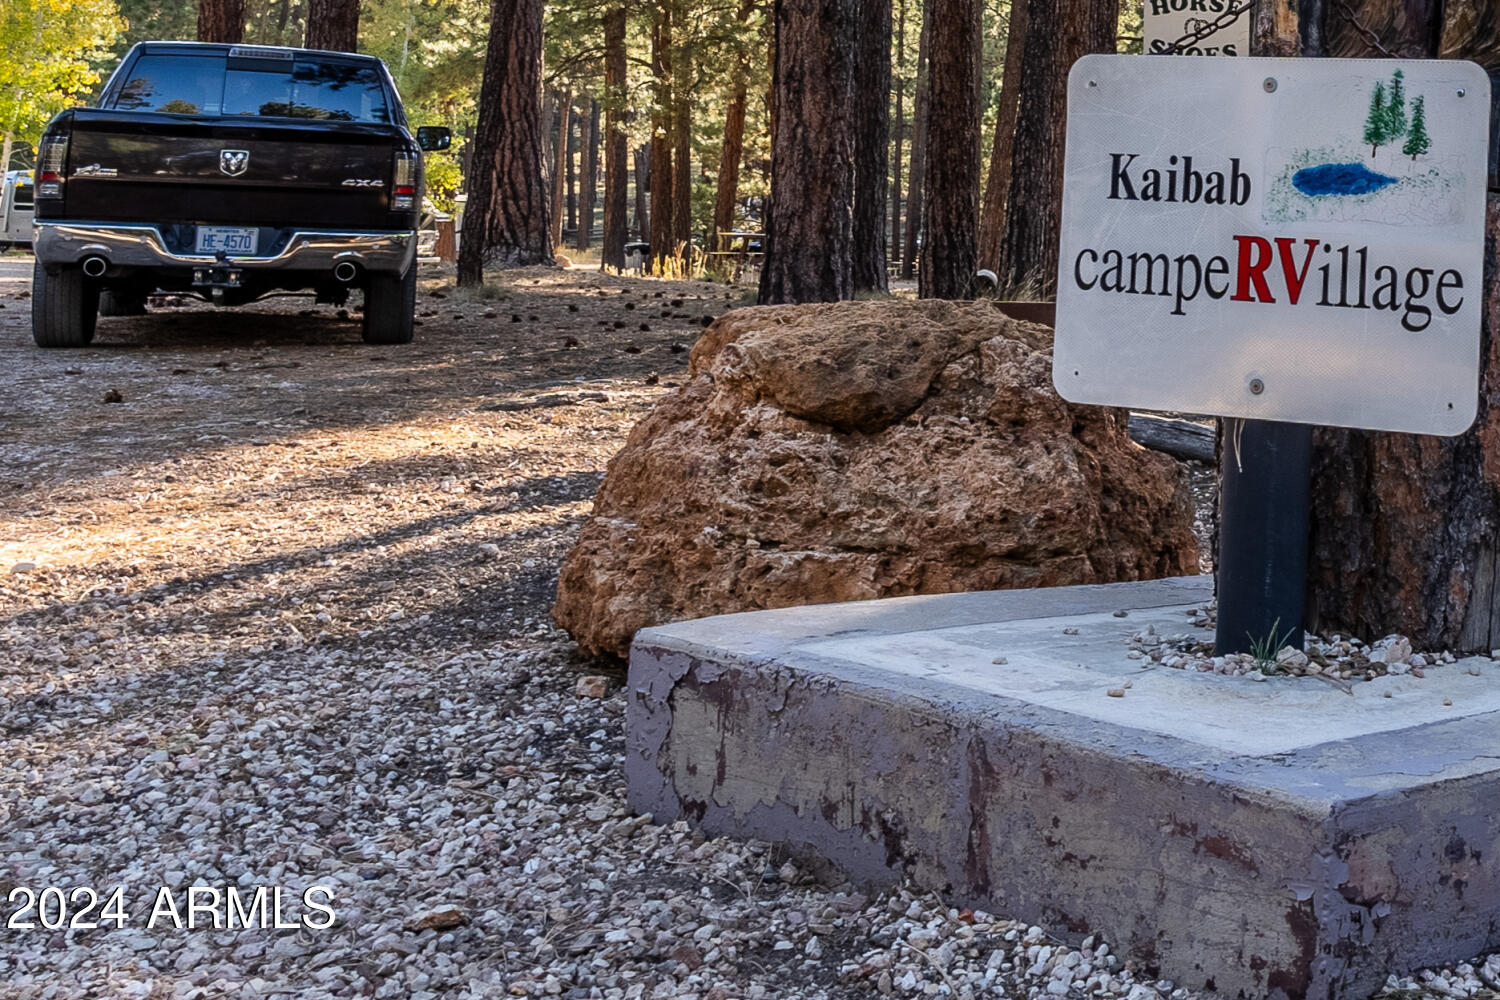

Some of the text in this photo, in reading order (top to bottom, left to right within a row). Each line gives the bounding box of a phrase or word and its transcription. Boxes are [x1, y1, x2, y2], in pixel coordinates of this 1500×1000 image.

[1106, 152, 1252, 207] Kaibab
[202, 233, 252, 249] HE-4570
[1073, 234, 1464, 332] campeRVillage
